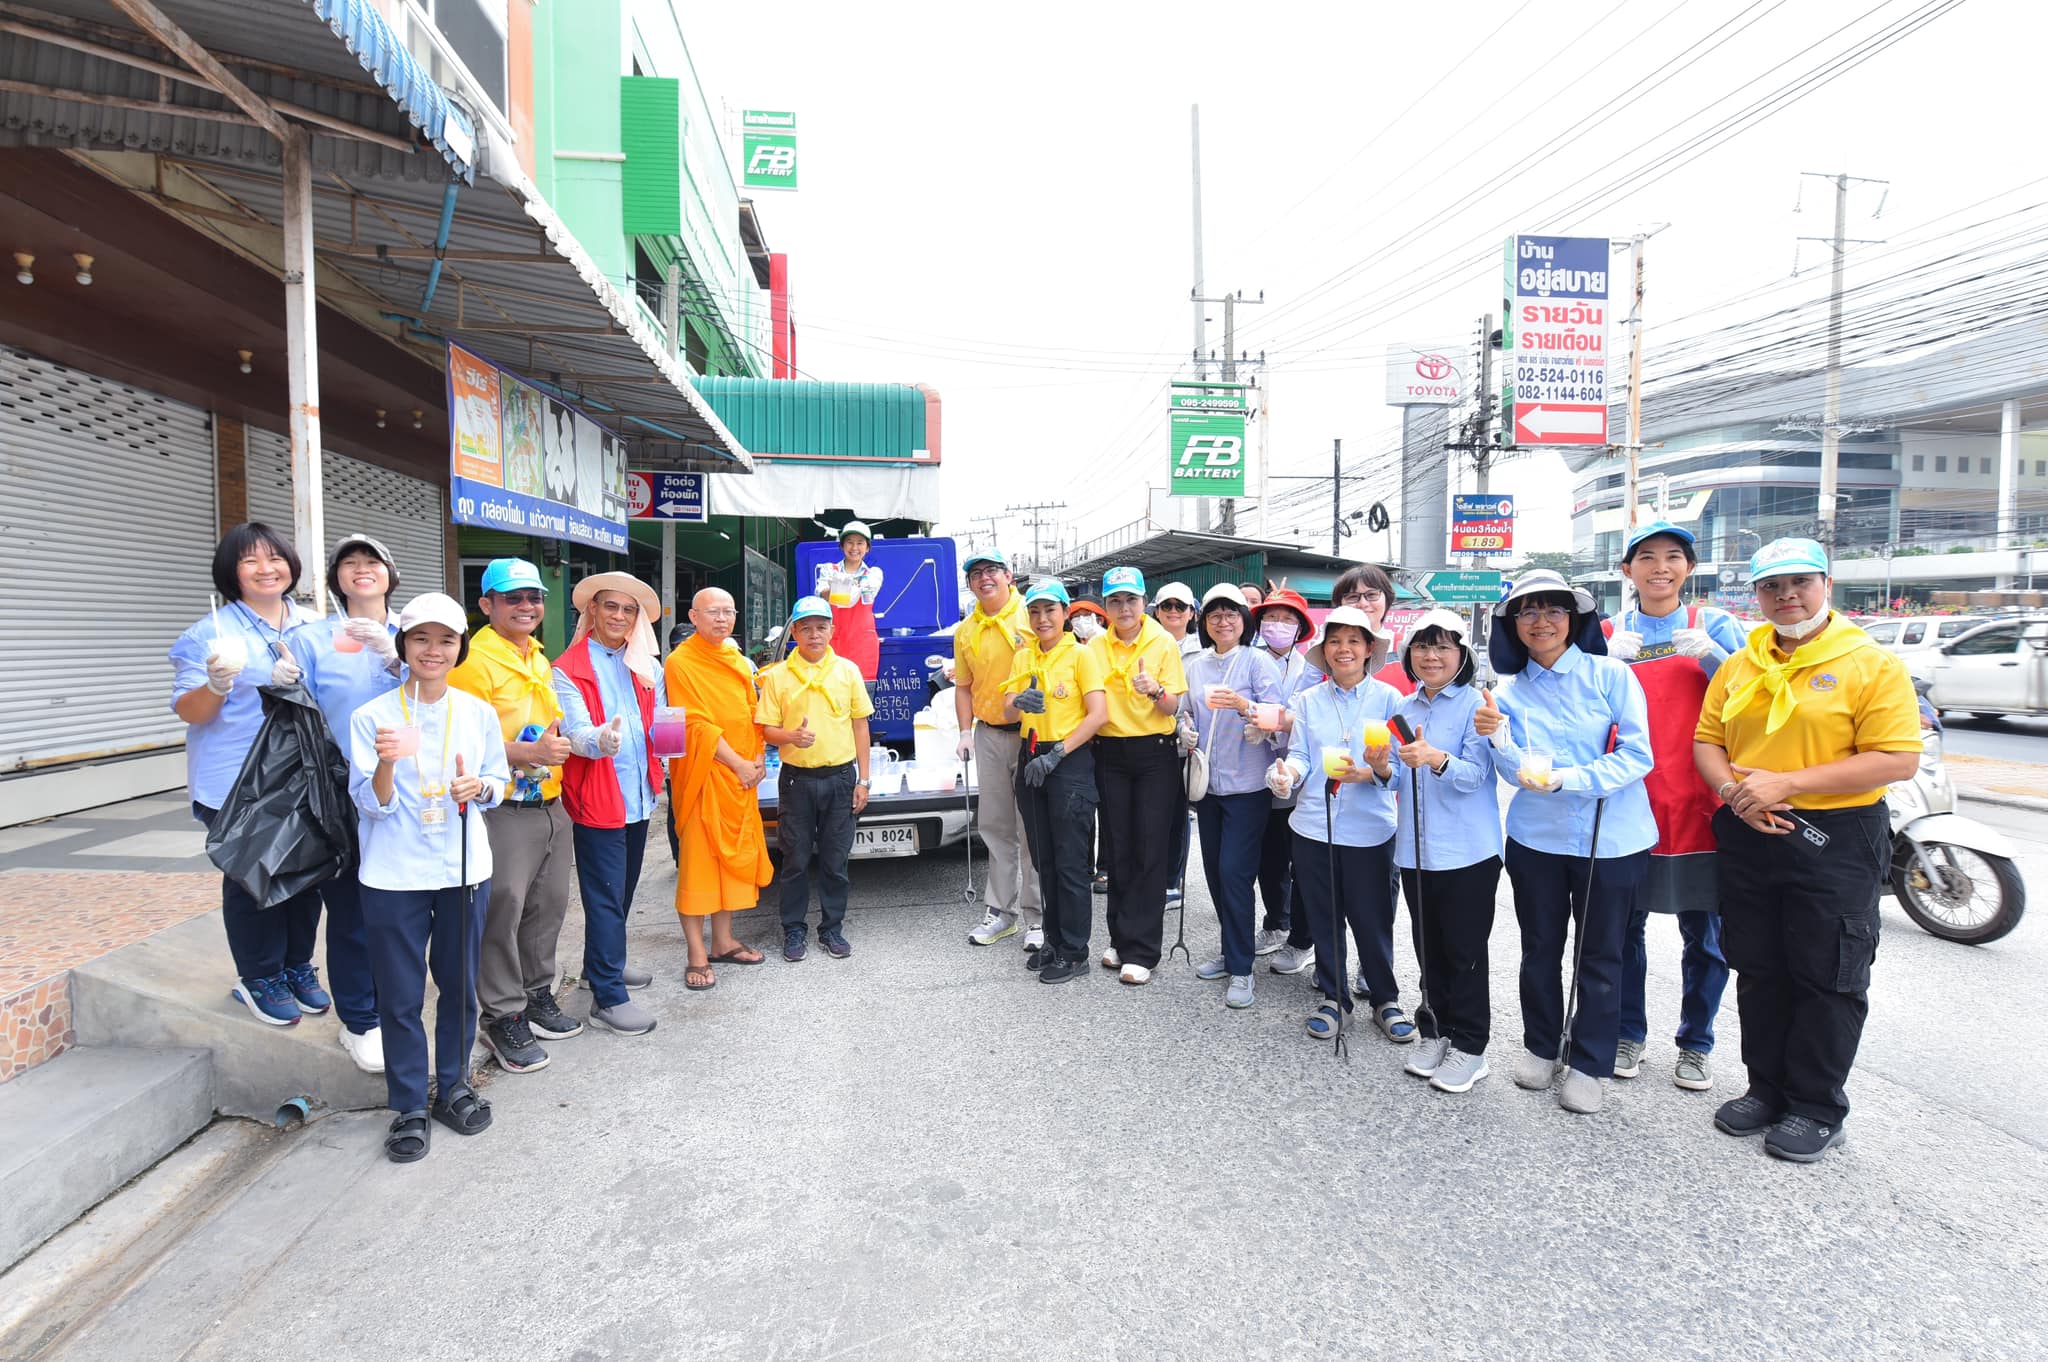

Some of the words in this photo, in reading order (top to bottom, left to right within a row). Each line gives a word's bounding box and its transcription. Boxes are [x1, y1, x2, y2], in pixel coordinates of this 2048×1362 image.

[748, 145, 796, 169] FB
[747, 167, 793, 177] BATTERY
[1520, 240, 1554, 260] บ้าน
[1520, 262, 1606, 297] อยู่สบาย
[1522, 301, 1603, 326] รายวัน
[1521, 327, 1602, 352] รายเดือน
[1517, 367, 1604, 384] 02-524-0116
[1407, 386, 1457, 397] TOYOTA
[1517, 385, 1603, 401] 082-1144-604
[1179, 434, 1242, 466] FB
[664, 475, 696, 487] ติดต่อ
[1173, 467, 1242, 479] BATTERY
[628, 479, 640, 487] าน
[660, 487, 699, 500] ห้องพัก
[458, 496, 475, 521] ถุง
[481, 498, 525, 525] กล่องโฟม
[529, 508, 566, 533] แก้วกาแฟ
[1472, 537, 1497, 547] 1.89
[892, 665, 921, 691] น้ำแข็ง
[874, 695, 910, 708] 95764
[881, 828, 913, 842] 8024
